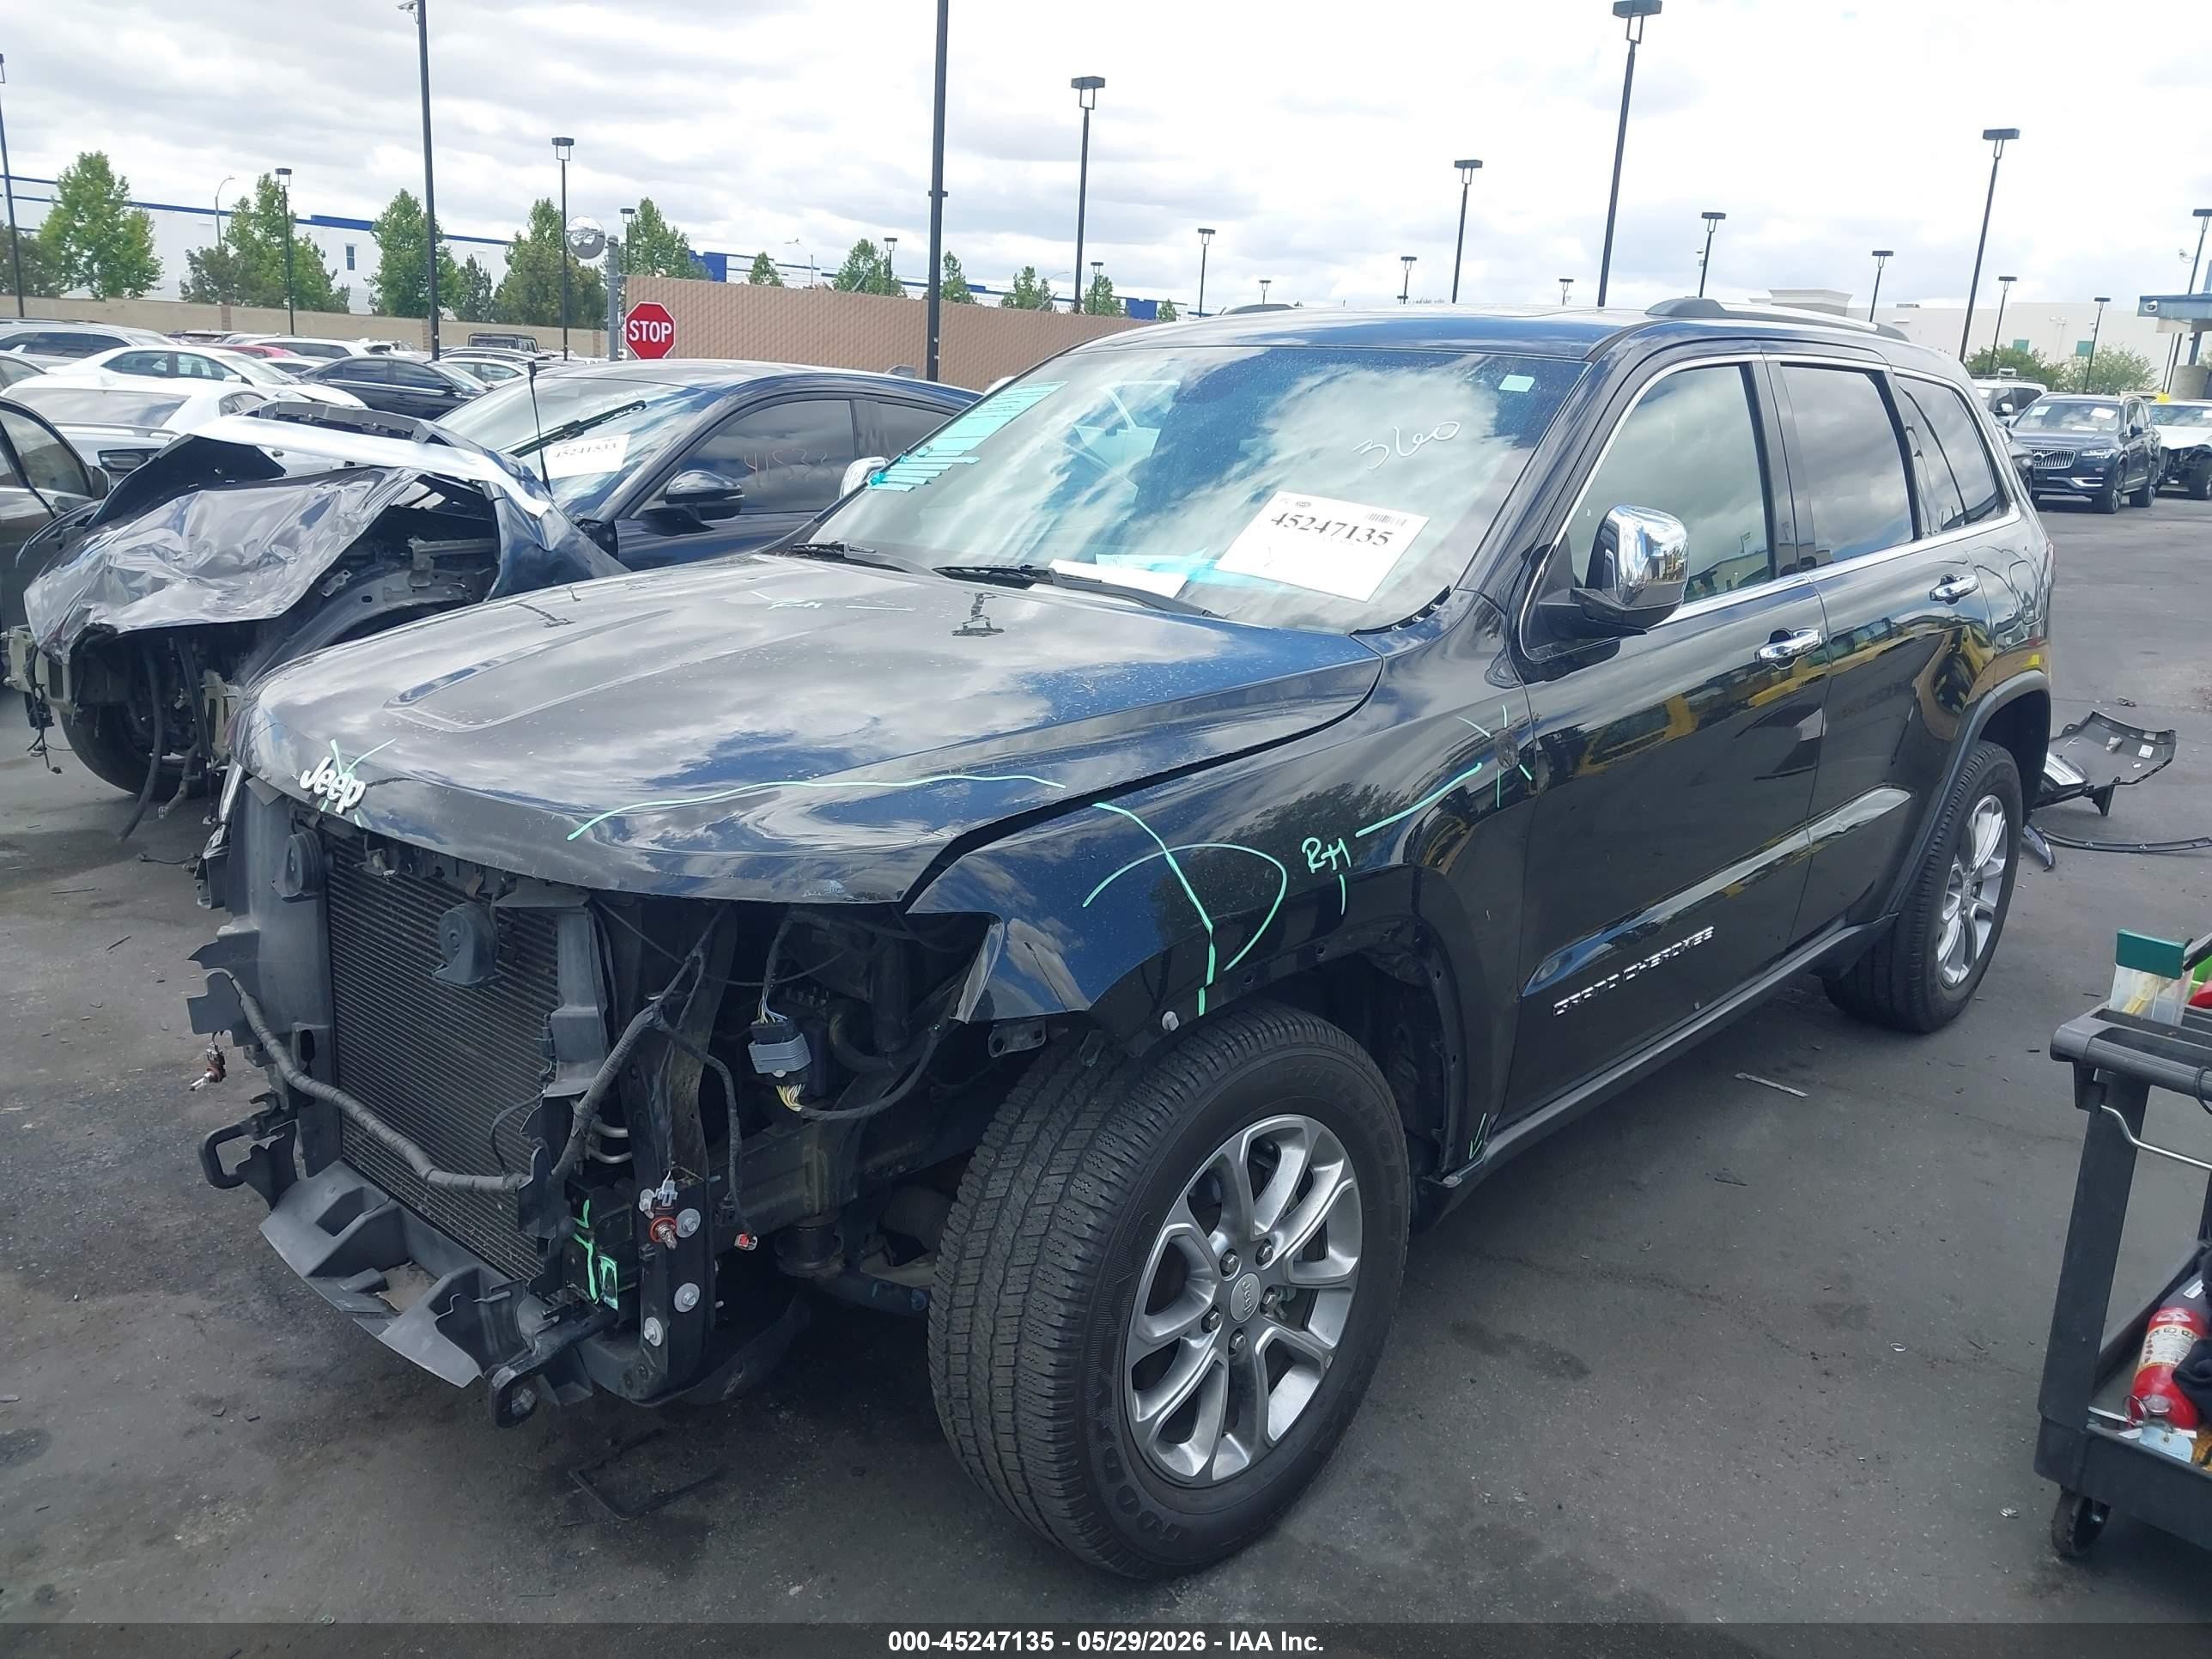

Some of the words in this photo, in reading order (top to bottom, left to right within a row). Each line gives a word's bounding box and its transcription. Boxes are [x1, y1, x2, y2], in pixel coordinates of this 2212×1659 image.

[628, 319, 672, 343] STOP
[1270, 512, 1395, 546] 45247135
[299, 757, 367, 814] Jeep
[1242, 1280, 1253, 1313] Jeep
